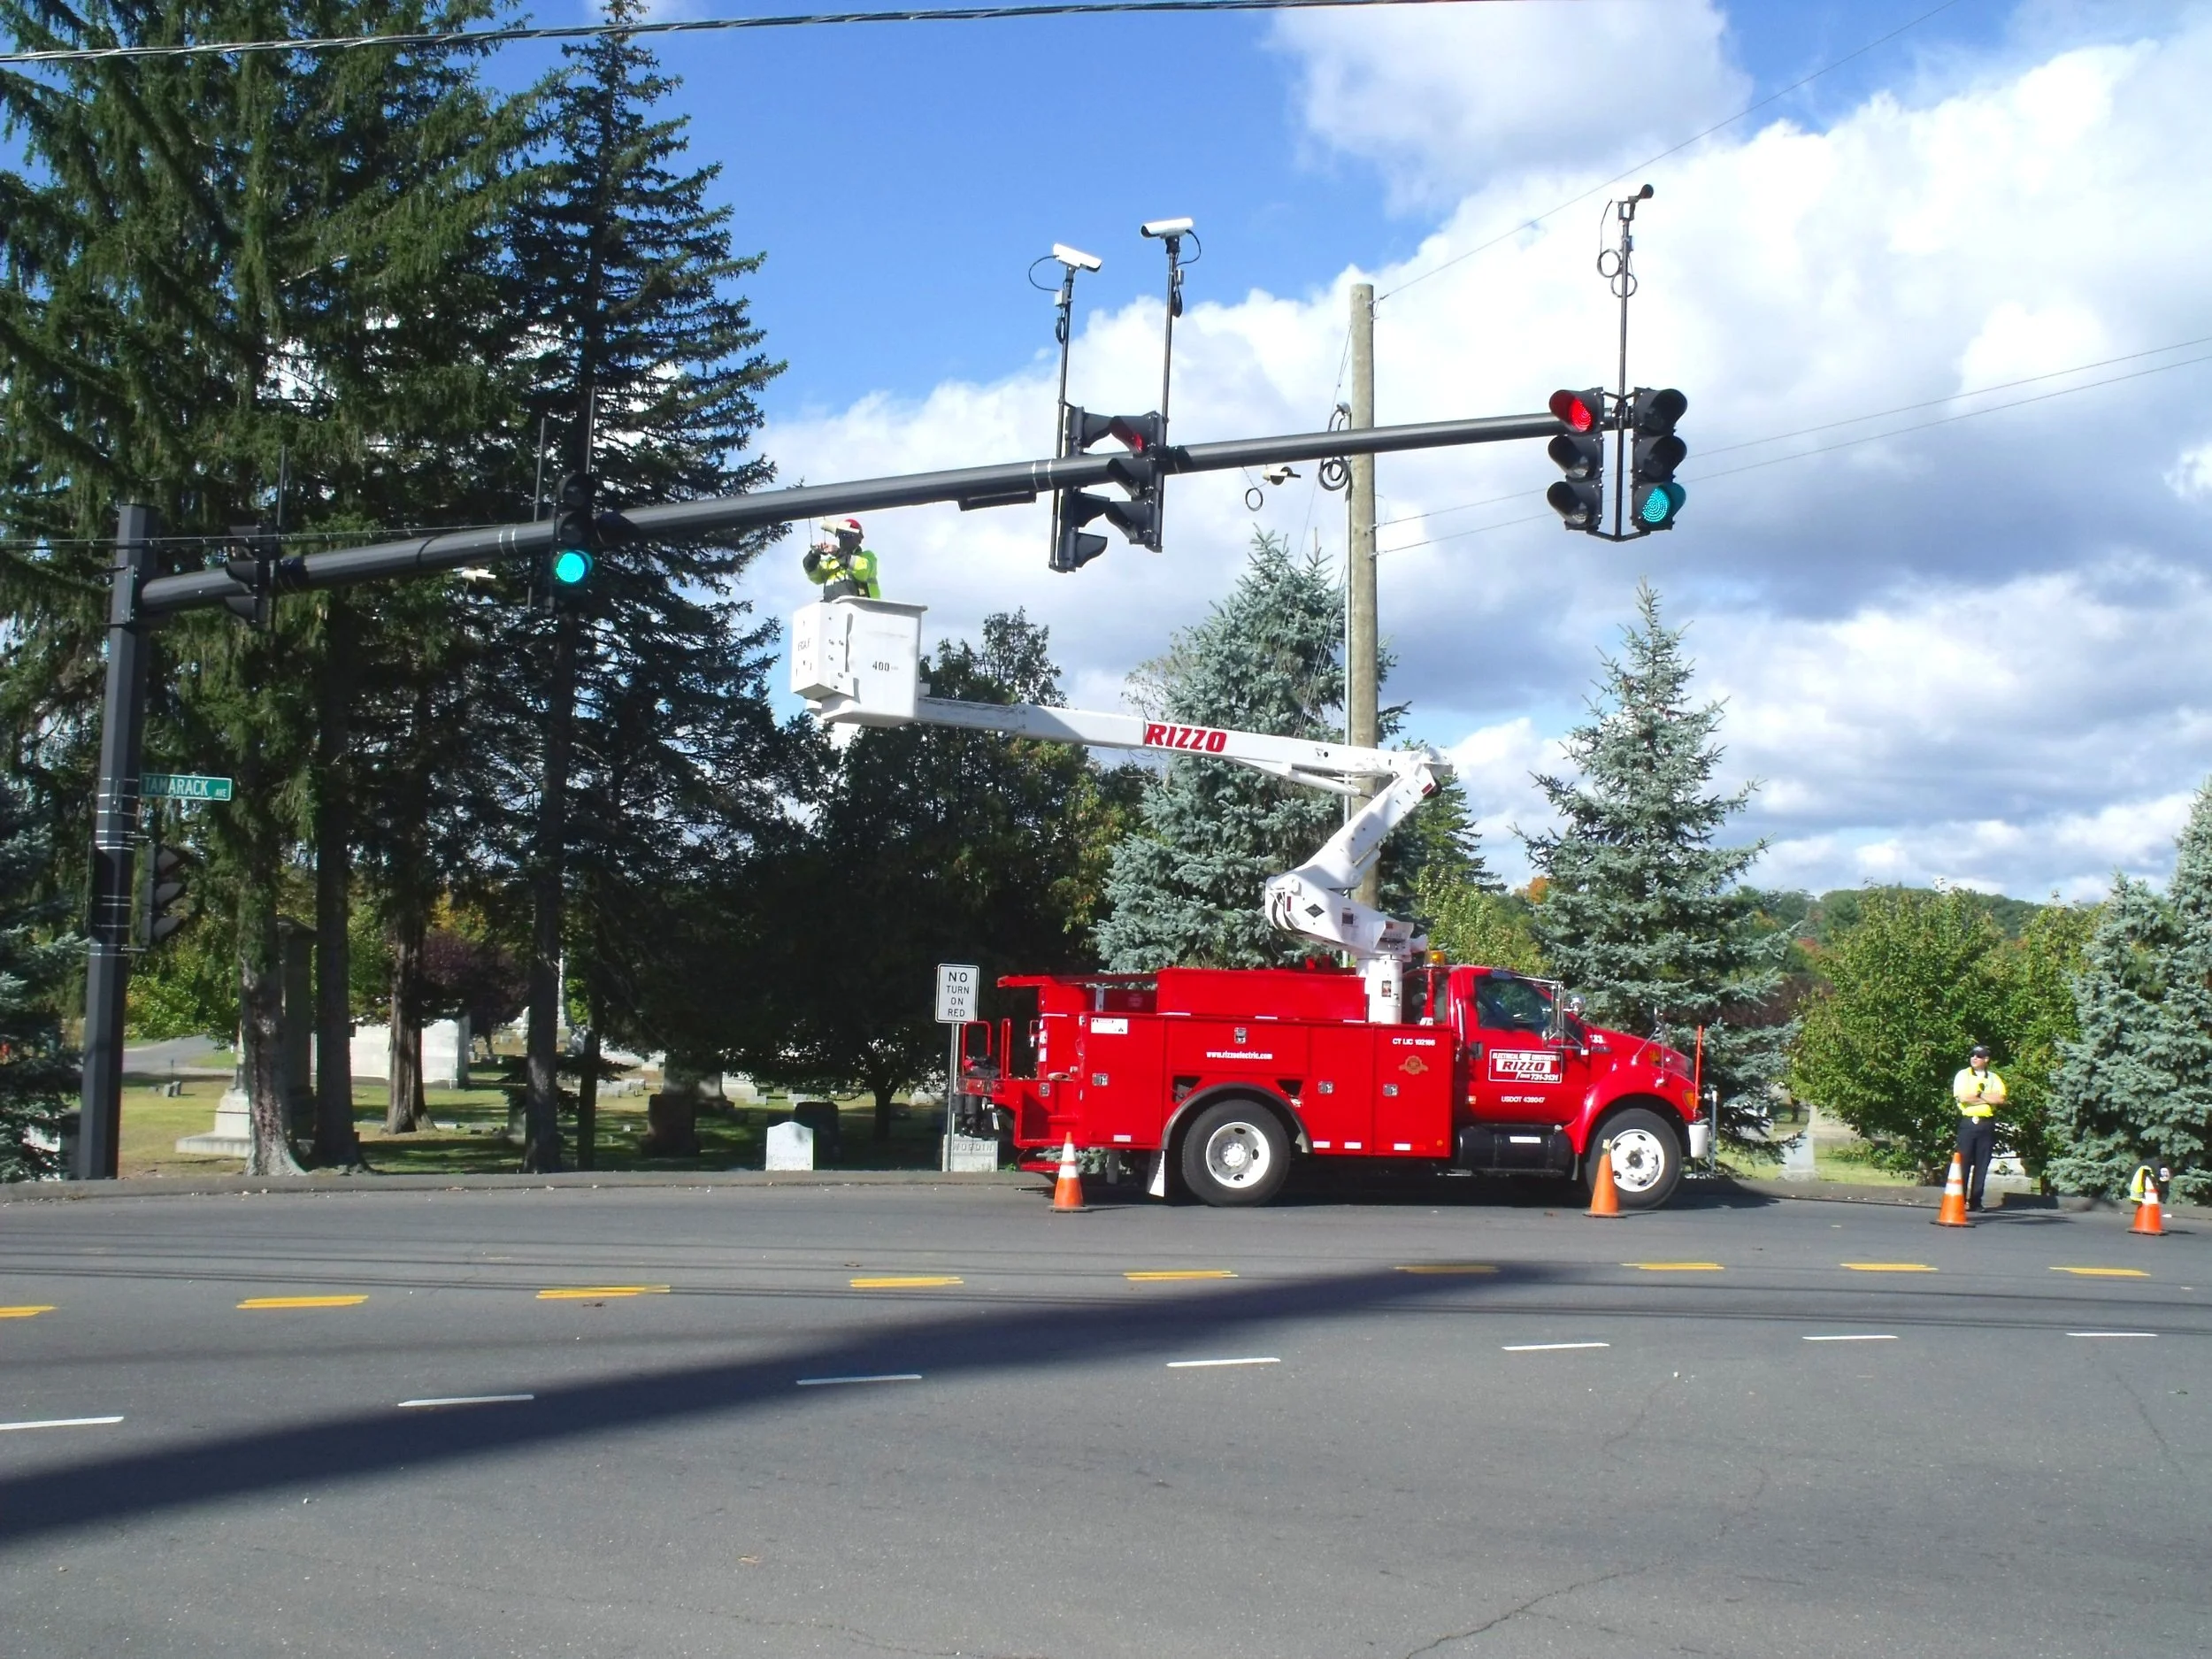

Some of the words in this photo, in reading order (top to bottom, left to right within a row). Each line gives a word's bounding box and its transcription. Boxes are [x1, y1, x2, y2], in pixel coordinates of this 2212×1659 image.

[872, 661, 890, 672] 400
[1145, 723, 1227, 753] RIZZO
[145, 777, 209, 796] TAMARACK
[215, 788, 227, 798] AVE
[949, 972, 968, 982] NO
[946, 985, 970, 995] TURN
[948, 1009, 965, 1018] RED
[1502, 1061, 1546, 1071] RIZZO
